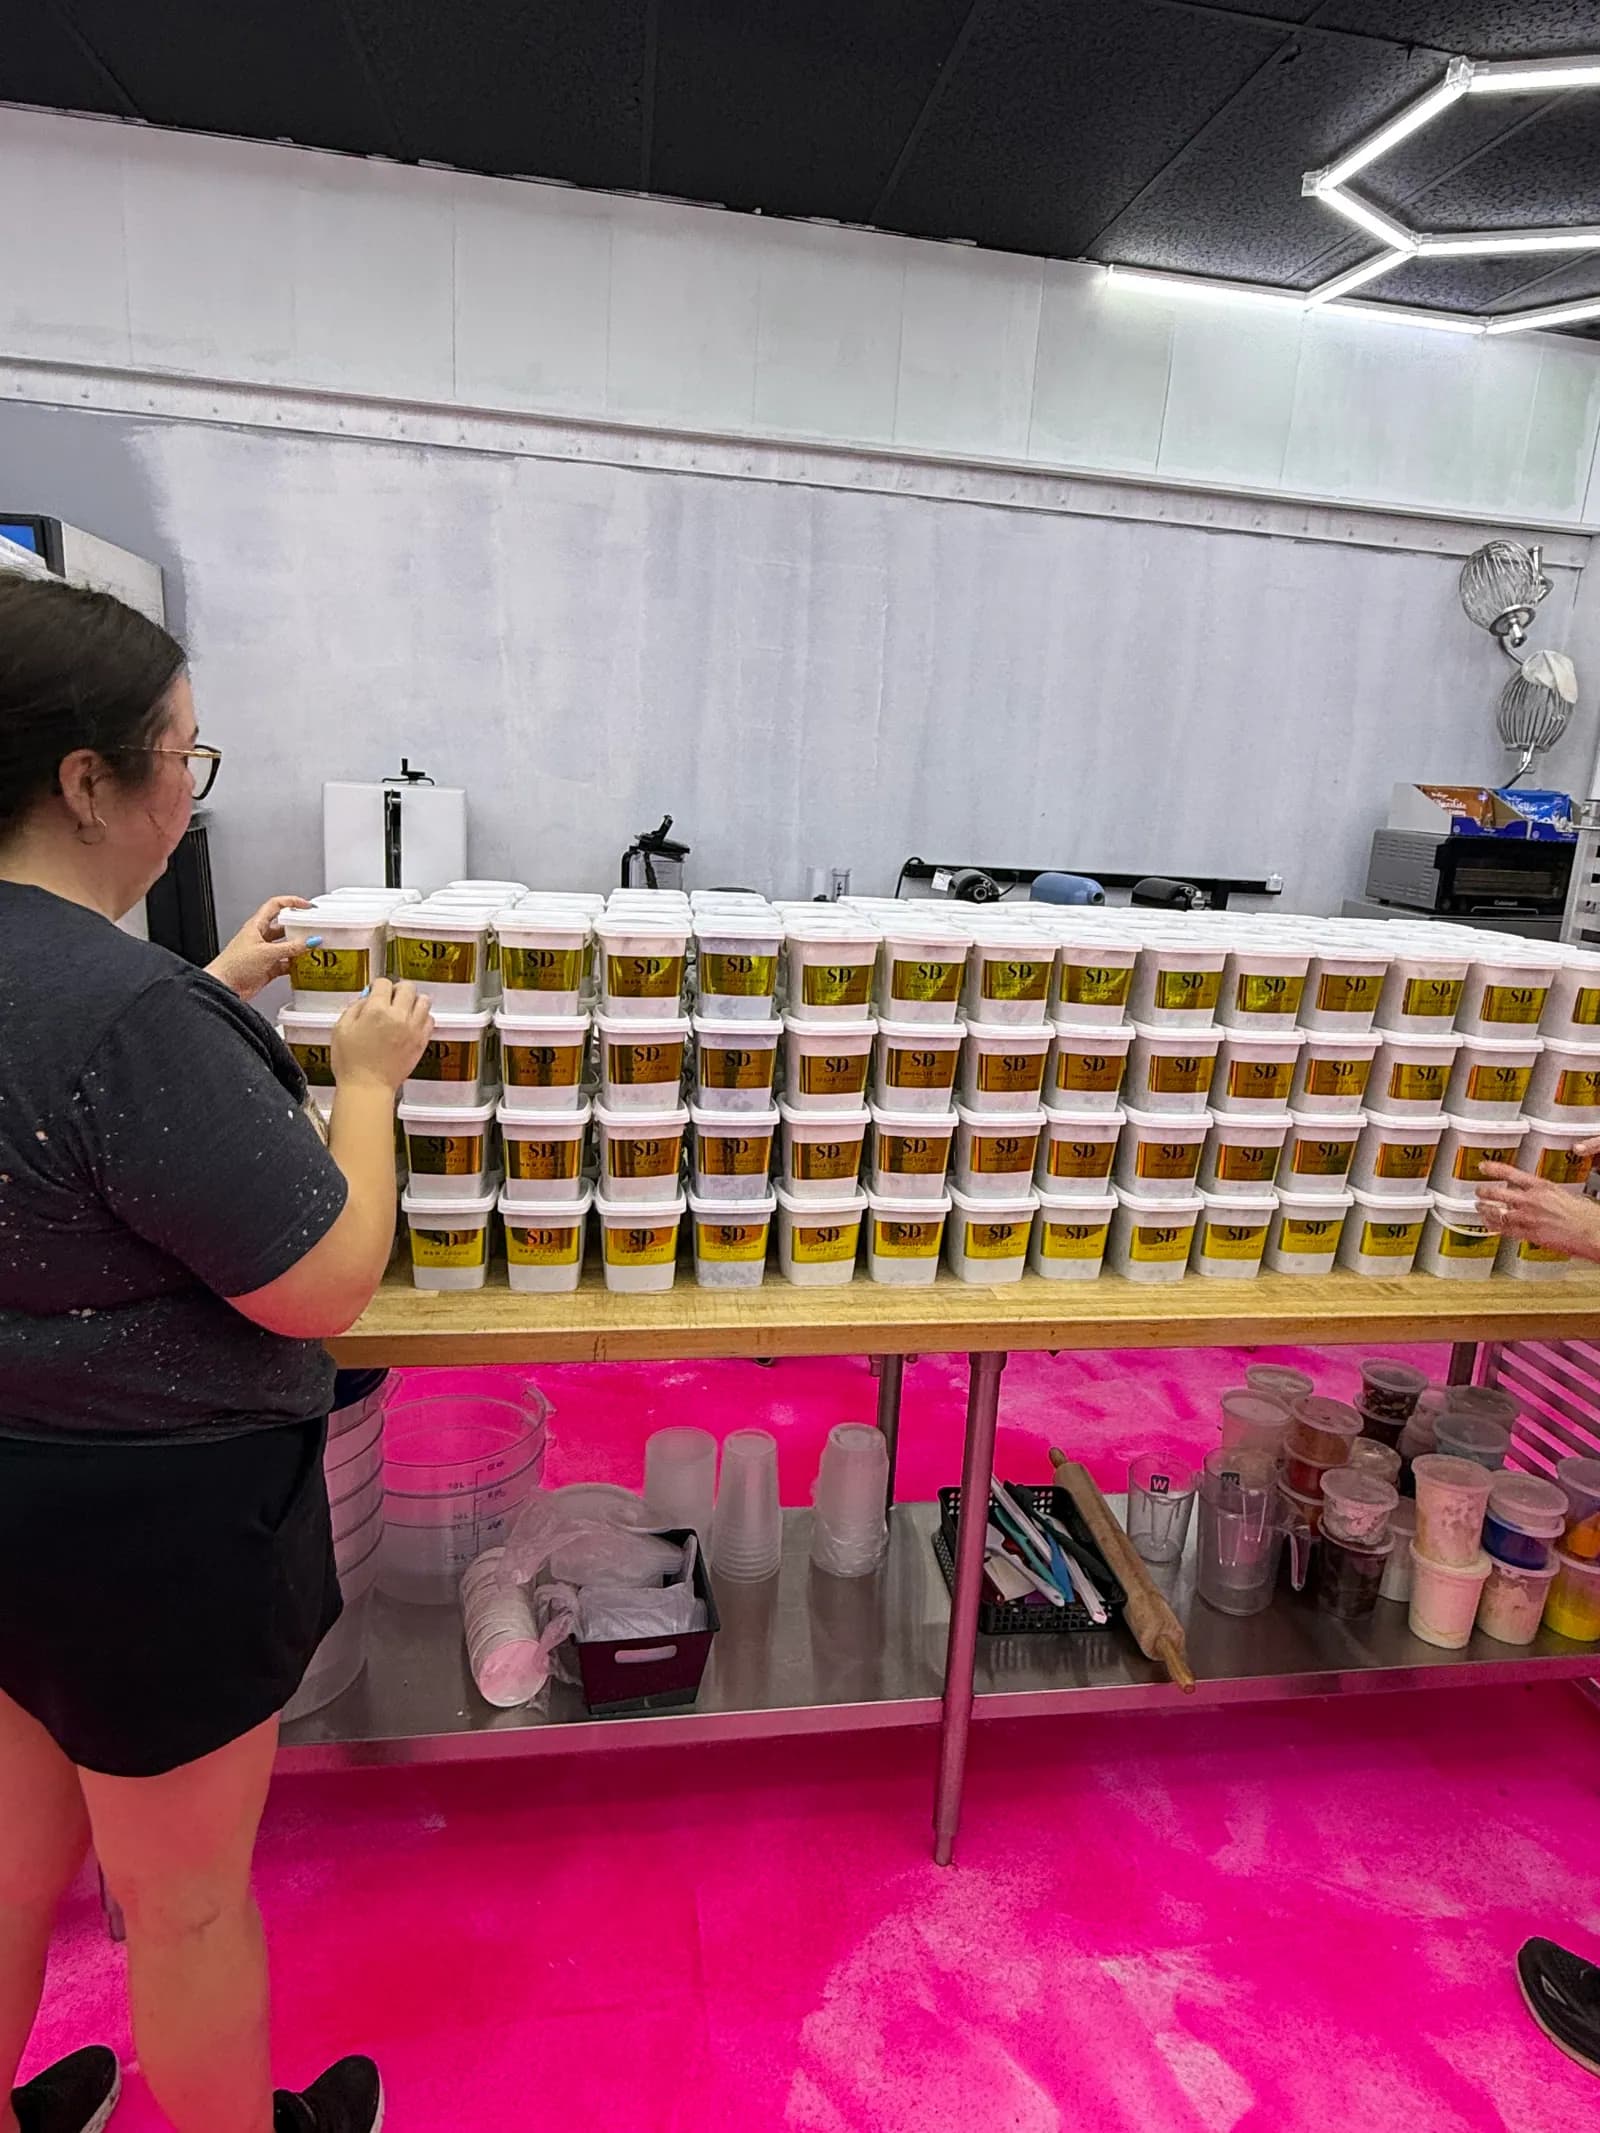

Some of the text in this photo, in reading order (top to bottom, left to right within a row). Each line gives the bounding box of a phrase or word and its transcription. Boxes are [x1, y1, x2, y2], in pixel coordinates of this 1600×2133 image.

[418, 943, 446, 960] SD
[310, 952, 337, 968] SD
[527, 951, 554, 967] SD
[727, 957, 752, 973] SD
[633, 959, 660, 975] SD
[918, 964, 942, 980] SD
[1008, 963, 1032, 978] SD
[827, 968, 851, 983] SD
[1086, 968, 1109, 984] SD
[1182, 975, 1204, 989] SD
[1264, 977, 1286, 993] SD
[1345, 977, 1366, 993] SD
[1431, 981, 1451, 996] SD
[1511, 990, 1532, 1003] SD
[529, 1048, 556, 1064] SD
[634, 1046, 660, 1062] SD
[725, 1052, 751, 1066] SD
[912, 1052, 935, 1067] SD
[825, 1057, 849, 1073] SD
[1003, 1056, 1026, 1071] SD
[1083, 1057, 1105, 1071] SD
[1175, 1058, 1197, 1072] SD
[1332, 1062, 1353, 1076] SD
[1255, 1064, 1277, 1078] SD
[1417, 1067, 1437, 1080] SD
[1496, 1068, 1516, 1082] SD
[428, 1138, 454, 1154] SD
[529, 1143, 555, 1158] SD
[633, 1141, 659, 1156] SD
[723, 1140, 749, 1154] SD
[816, 1144, 840, 1159] SD
[902, 1139, 927, 1153] SD
[996, 1138, 1019, 1153] SD
[1073, 1143, 1096, 1158] SD
[1162, 1145, 1184, 1159] SD
[1318, 1143, 1339, 1157] SD
[1403, 1146, 1422, 1159] SD
[1241, 1148, 1264, 1162] SD
[1482, 1150, 1503, 1161] SD
[721, 1227, 746, 1241] SD
[816, 1228, 840, 1242] SD
[898, 1224, 921, 1238] SD
[989, 1225, 1012, 1239] SD
[1066, 1226, 1088, 1239] SD
[1155, 1229, 1177, 1242] SD
[1228, 1227, 1250, 1240] SD
[1305, 1223, 1327, 1235] SD
[1387, 1224, 1407, 1238] SD
[432, 1232, 459, 1246] SD
[527, 1230, 553, 1245] SD
[629, 1231, 655, 1245] SD
[1152, 1478, 1168, 1491] W
